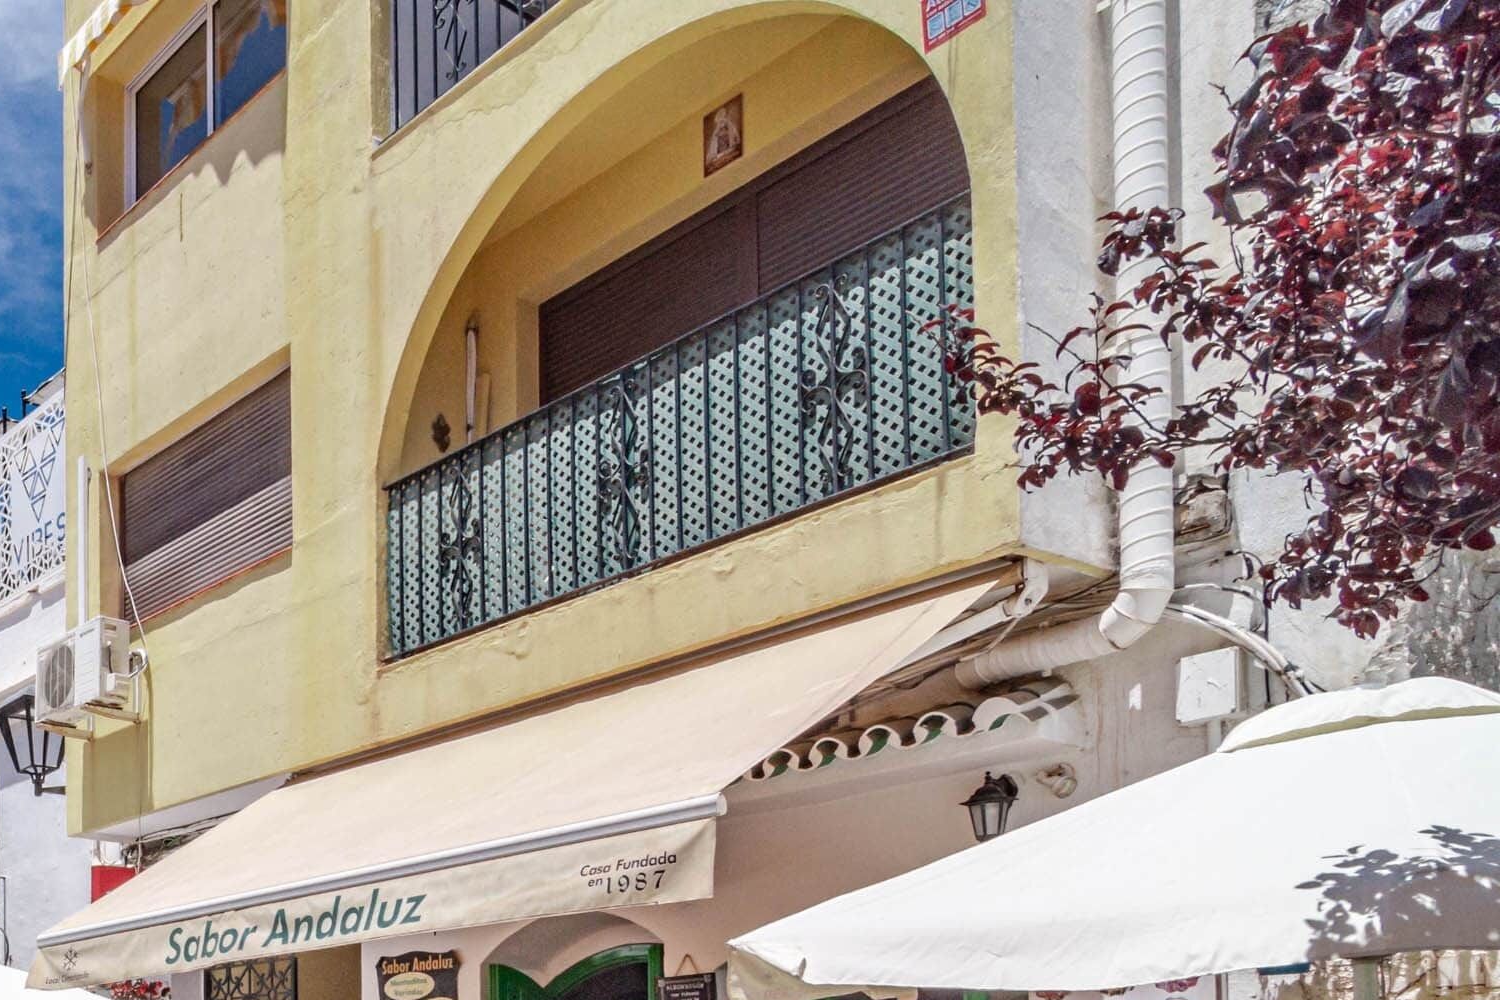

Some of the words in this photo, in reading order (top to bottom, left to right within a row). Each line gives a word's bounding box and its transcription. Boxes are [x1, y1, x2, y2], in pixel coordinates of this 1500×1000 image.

[580, 863, 612, 877] Casa
[615, 851, 677, 871] Fundada
[587, 877, 603, 887] en
[606, 869, 666, 894] 1987
[164, 919, 258, 965] Sabor
[261, 887, 428, 948] Andaluz
[381, 960, 410, 975] Sabor
[412, 954, 454, 973] Andaluz
